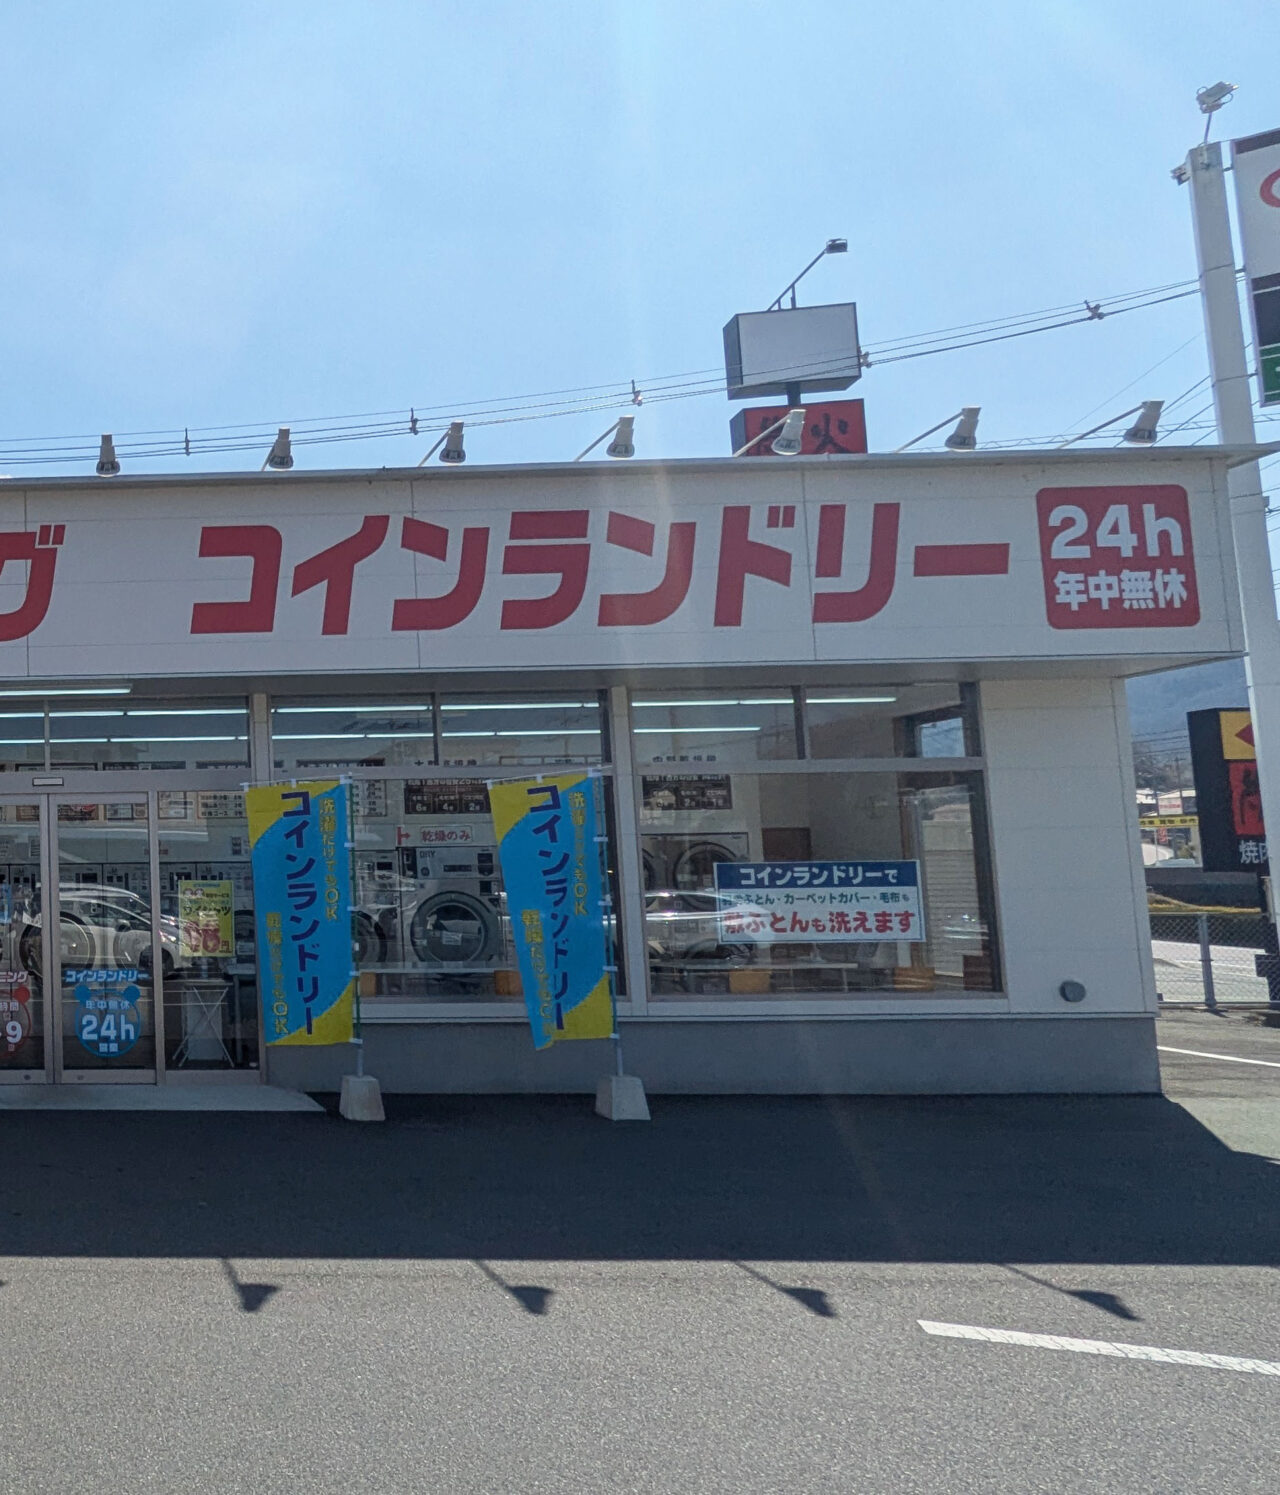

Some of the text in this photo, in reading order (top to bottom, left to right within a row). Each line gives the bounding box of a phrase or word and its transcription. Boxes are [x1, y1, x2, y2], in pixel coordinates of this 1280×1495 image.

[1048, 503, 1185, 561] 24h
[190, 503, 1011, 636] コインランドリー
[1054, 567, 1188, 613] 年中無休
[421, 830, 471, 843] 乾燥のみ
[739, 865, 898, 886] コインランドリーで
[281, 791, 320, 1034] コインランドリー
[527, 784, 570, 1031] コインランドリー
[65, 969, 150, 983] コインランドリー
[6, 1021, 23, 1044] 9
[82, 1013, 135, 1041] 24h
